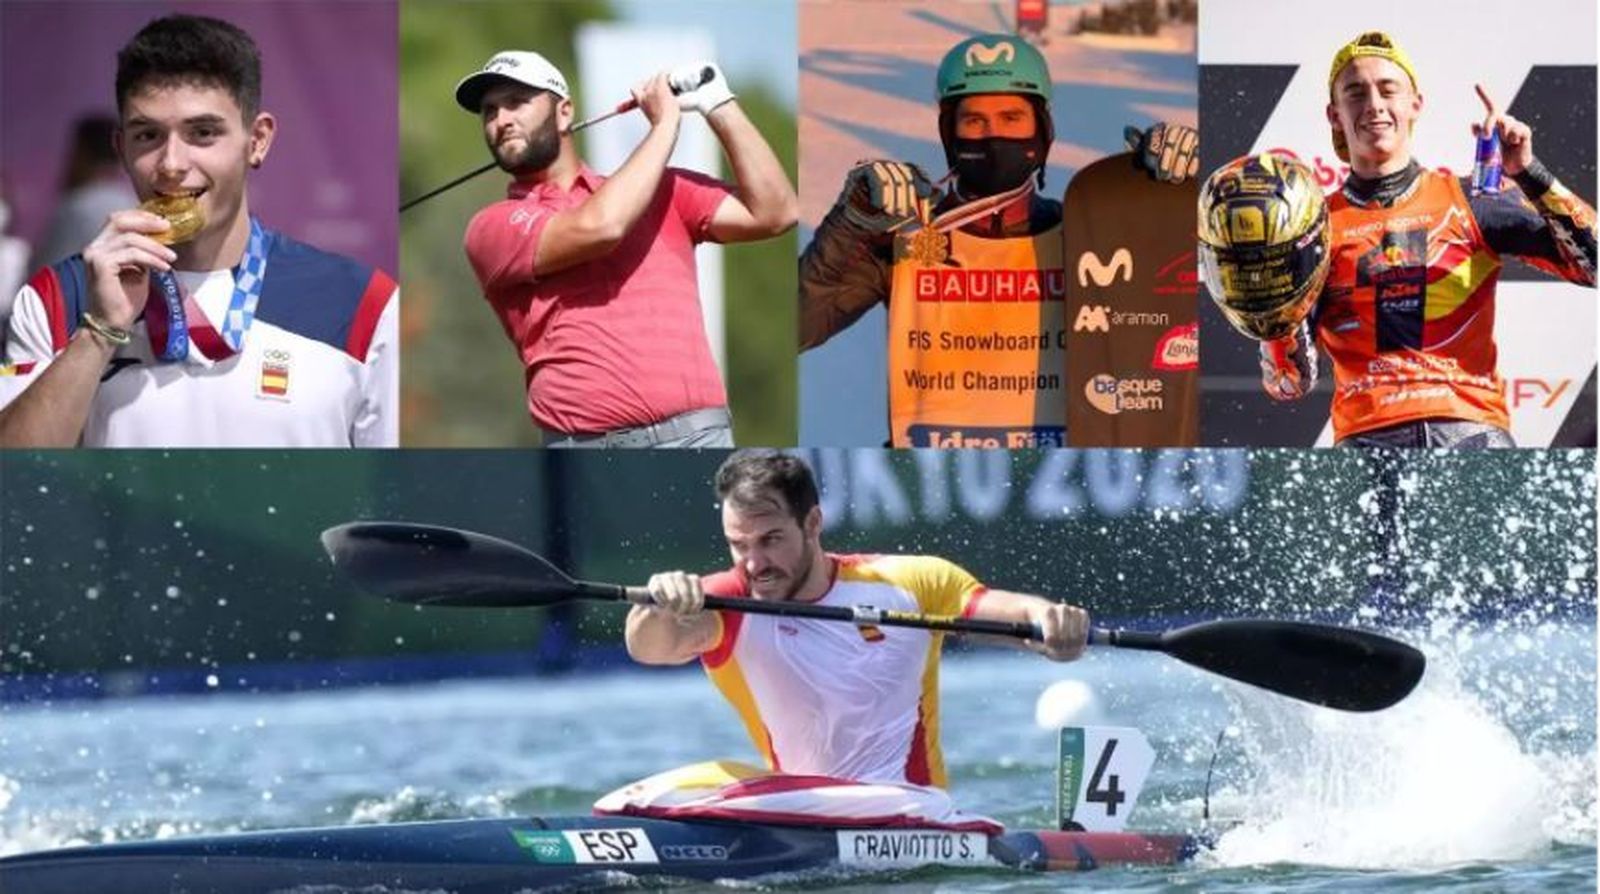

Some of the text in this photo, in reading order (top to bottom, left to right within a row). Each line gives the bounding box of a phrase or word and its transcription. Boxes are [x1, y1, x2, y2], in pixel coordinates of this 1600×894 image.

[1111, 311, 1169, 326] aramon
[940, 330, 1050, 351] Snowboard
[904, 370, 1060, 396] World Champion
[1094, 376, 1163, 397] basque
[1116, 391, 1163, 410] team
[1026, 448, 1248, 519] 2020
[1086, 738, 1125, 816] 4
[579, 831, 638, 861] ESP
[854, 833, 976, 858] CRAVIOTTO S.
